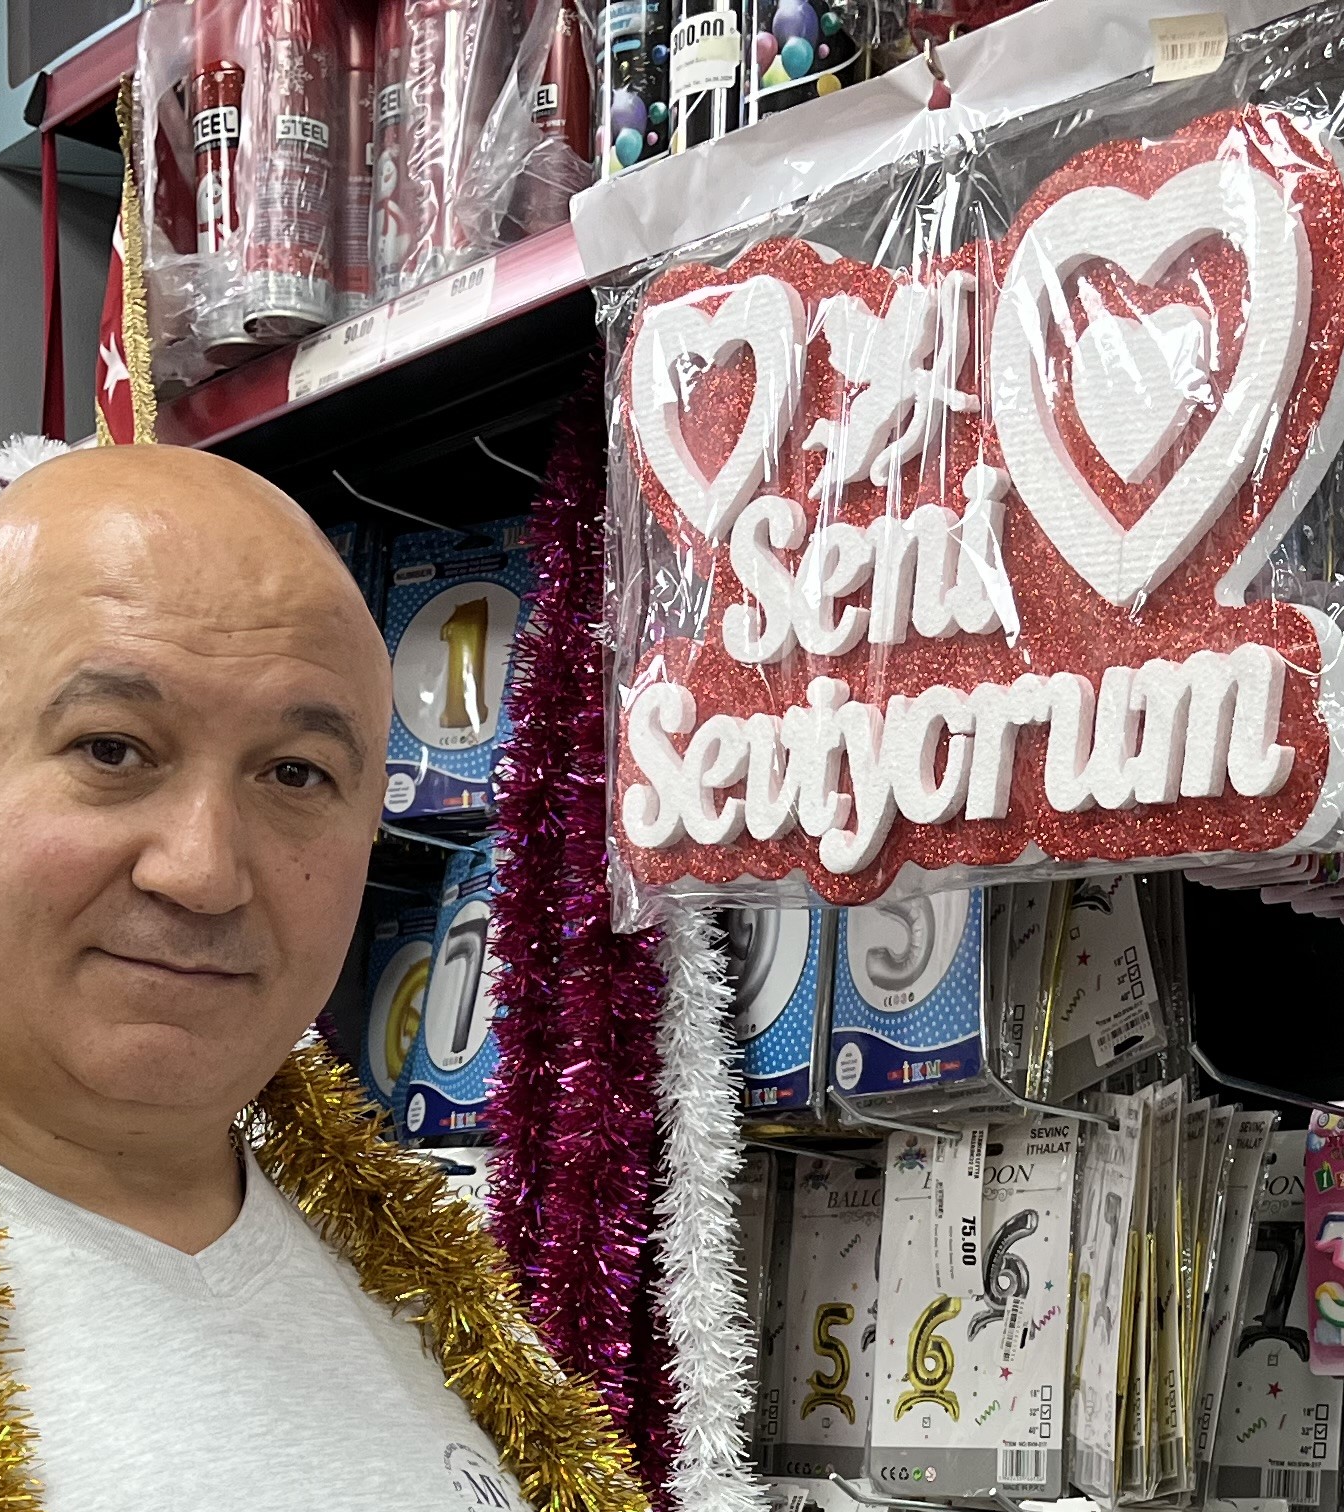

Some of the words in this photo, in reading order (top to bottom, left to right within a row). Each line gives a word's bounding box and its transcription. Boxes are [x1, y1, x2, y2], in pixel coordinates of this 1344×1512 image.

[280, 117, 328, 147] STEEL
[723, 466, 1017, 666] Seni
[440, 596, 490, 730] 1
[961, 1216, 976, 1266] 75.00
